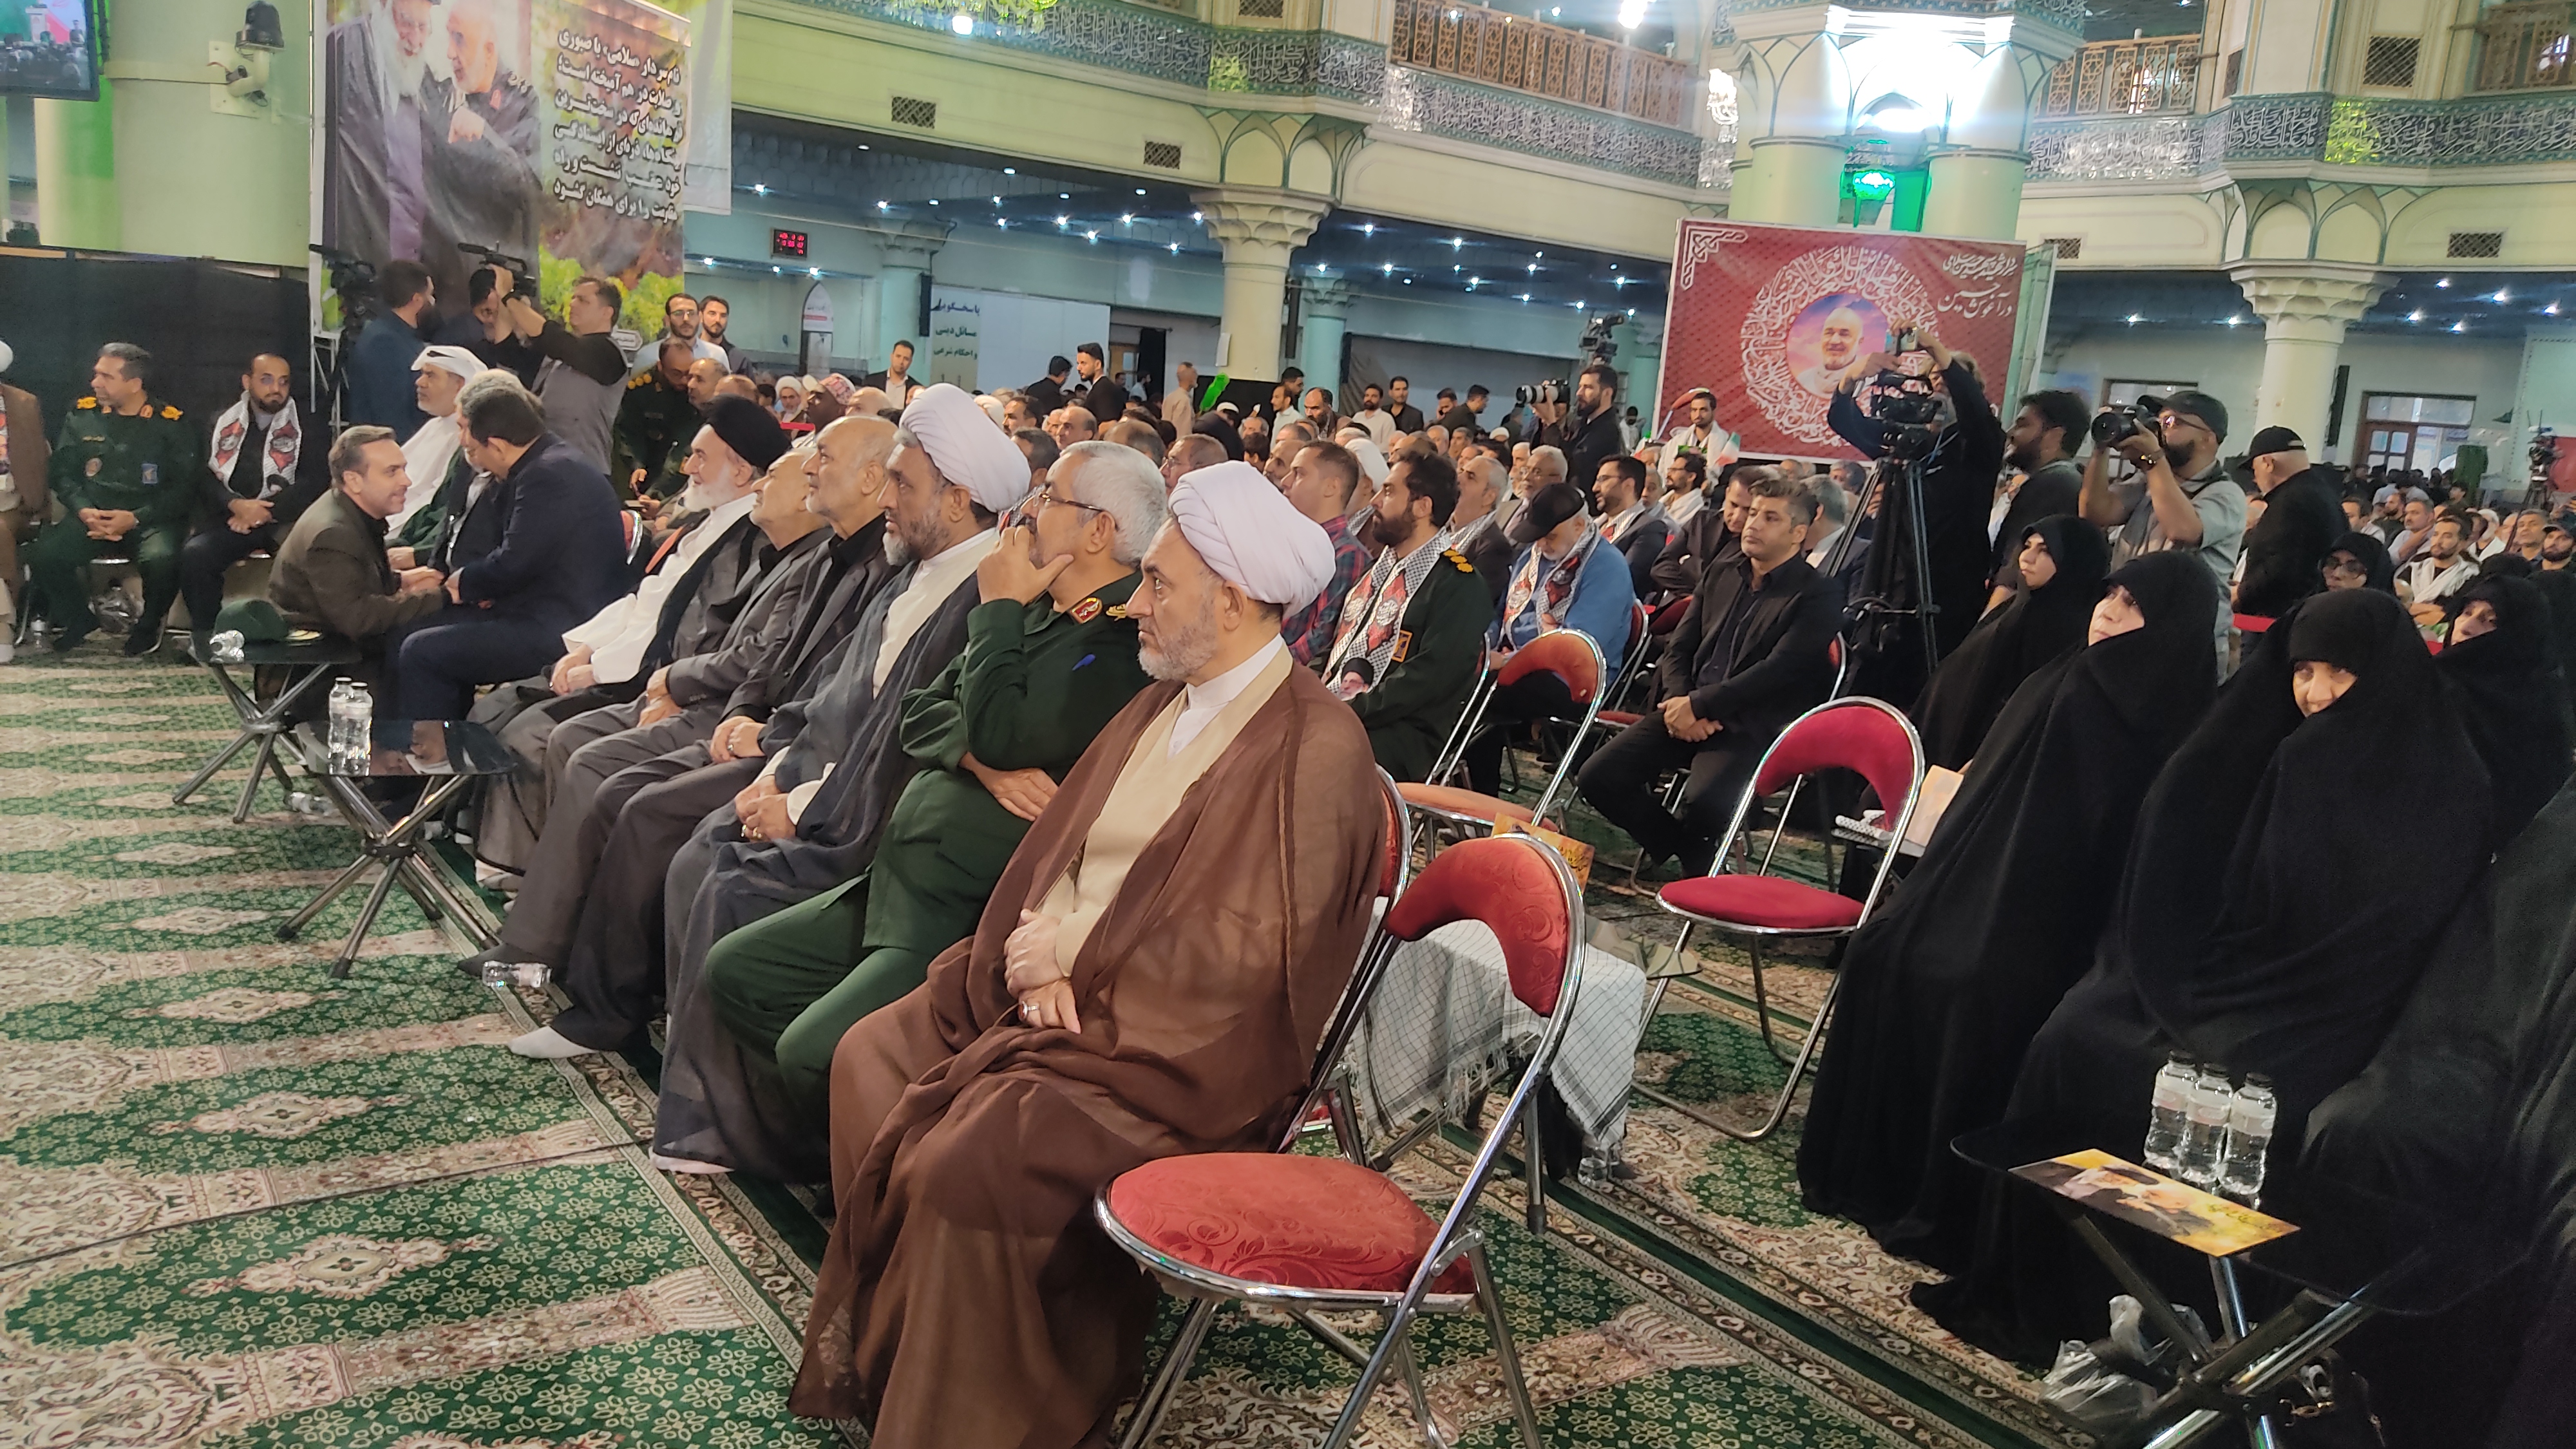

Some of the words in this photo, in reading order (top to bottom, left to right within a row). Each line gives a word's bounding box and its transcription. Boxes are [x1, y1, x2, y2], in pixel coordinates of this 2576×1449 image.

[558, 30, 593, 52] صبوری
[594, 36, 601, 59] با
[591, 68, 621, 92] آمیخته
[649, 89, 672, 110] صلابت
[615, 109, 628, 126] در
[629, 110, 640, 127] که
[554, 120, 606, 149] ایستادگی
[605, 131, 616, 153] از
[554, 148, 571, 171] راه
[571, 158, 579, 173] و
[554, 180, 586, 200] گشود
[625, 171, 663, 189] عقب
[585, 187, 614, 207] همگان
[615, 194, 637, 217] برای
[638, 197, 650, 220] را
[1937, 282, 2002, 313] حسین
